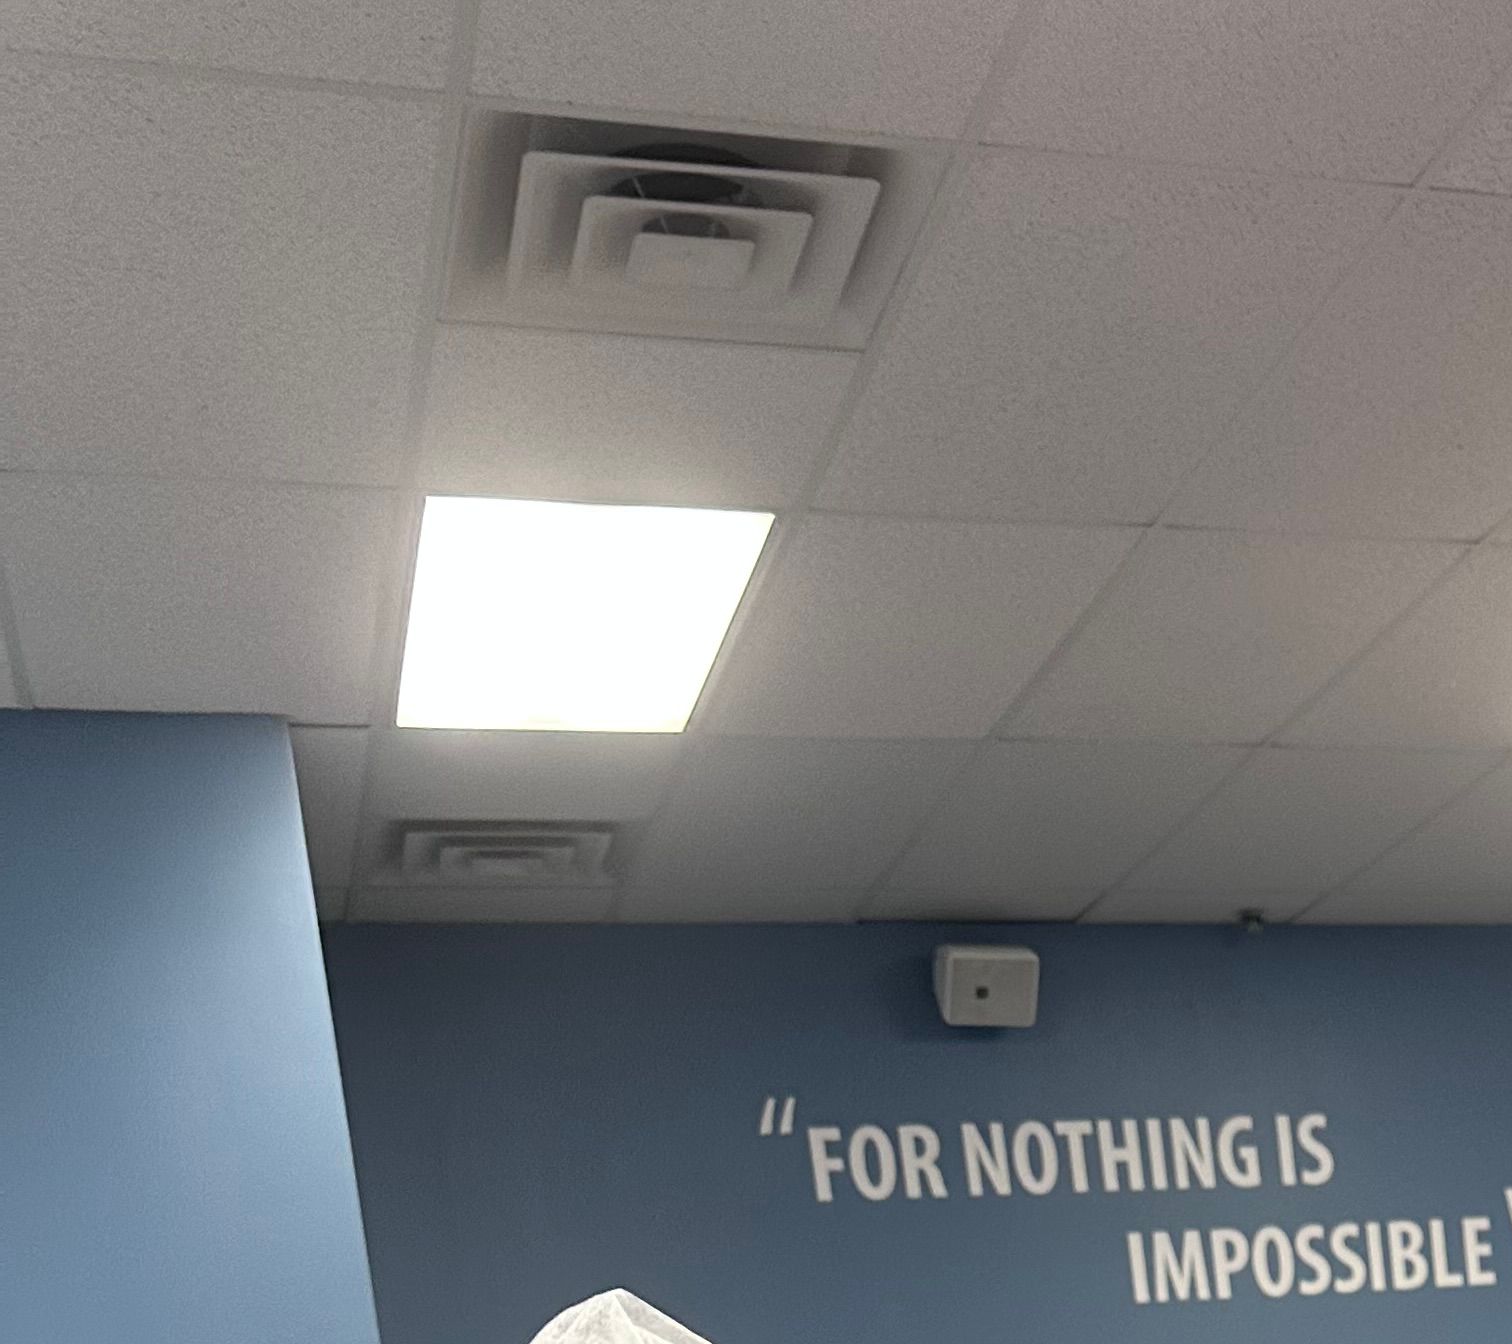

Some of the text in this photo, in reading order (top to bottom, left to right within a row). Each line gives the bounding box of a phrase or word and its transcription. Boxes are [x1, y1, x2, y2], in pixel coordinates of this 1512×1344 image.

[961, 1114, 1257, 1197] NOTHING
[1274, 1112, 1335, 1187] IS
[1126, 1216, 1494, 1305] IMPOSSIBLE
